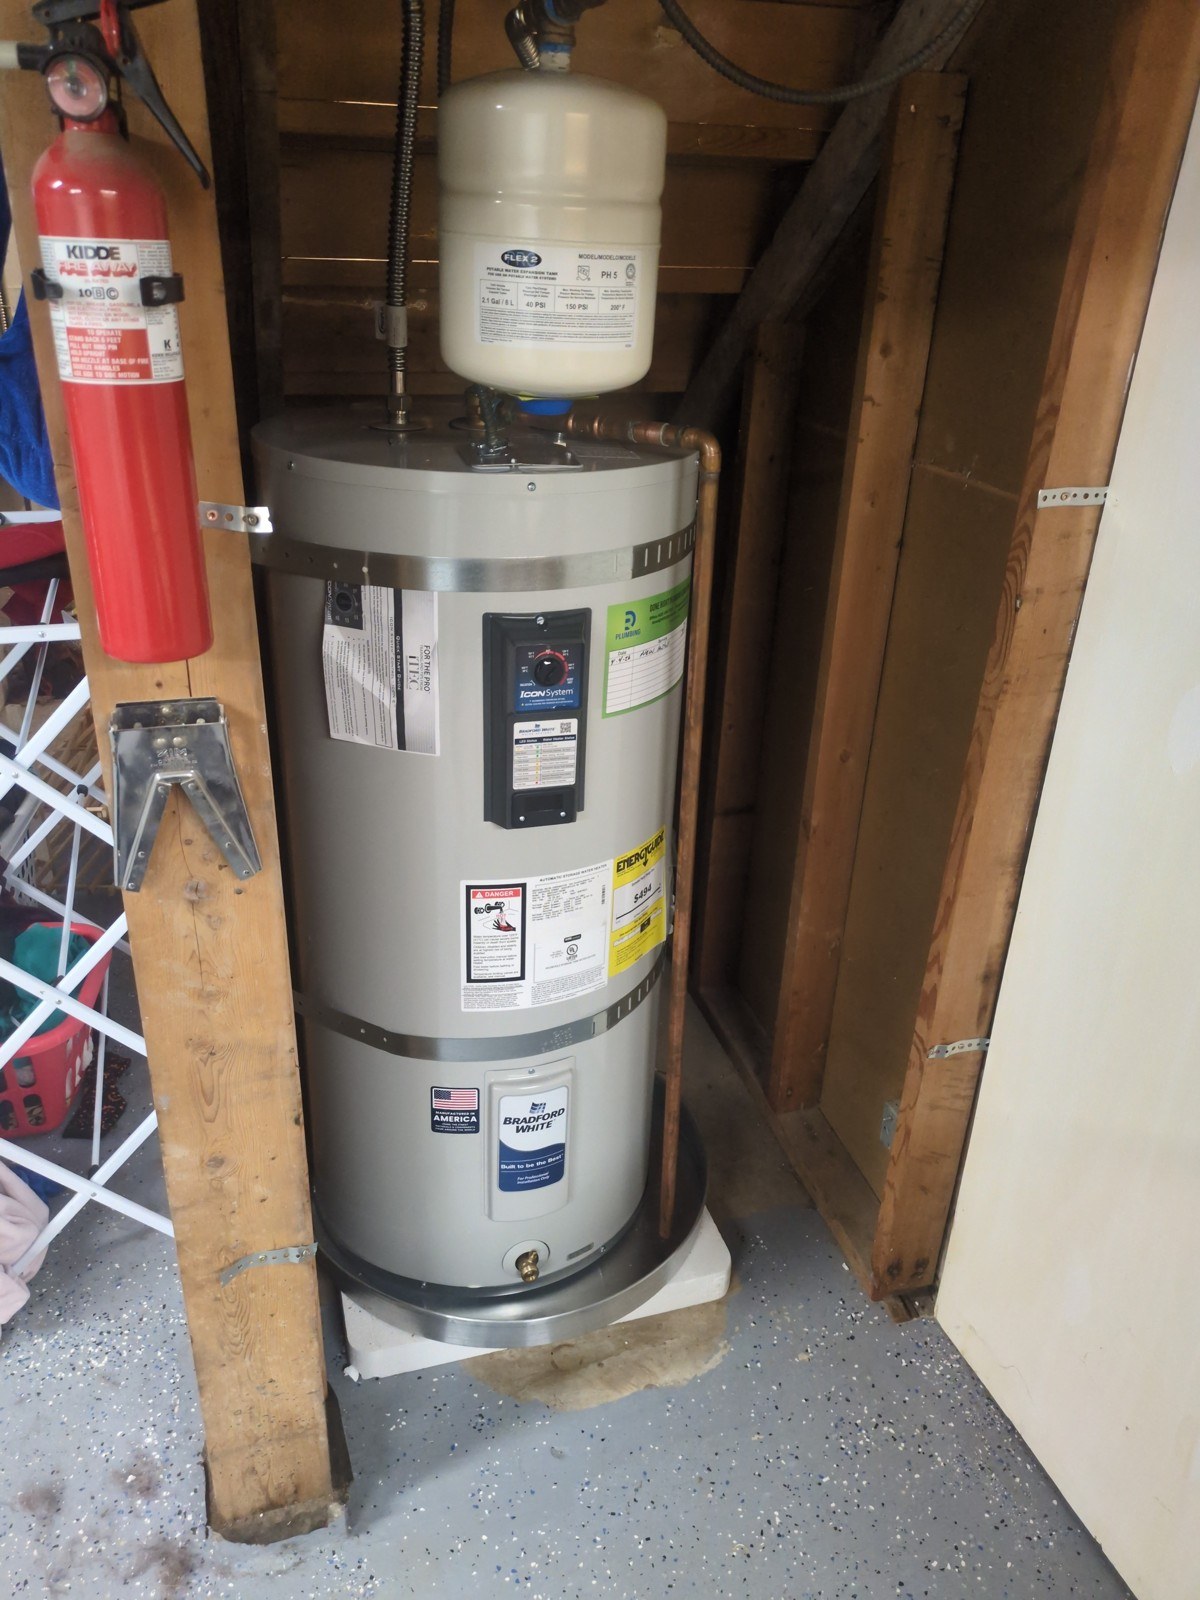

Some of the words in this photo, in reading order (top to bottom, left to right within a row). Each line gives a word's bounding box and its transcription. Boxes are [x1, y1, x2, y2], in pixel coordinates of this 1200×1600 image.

[66, 245, 121, 260] KIDDE
[504, 254, 528, 262] FLEX
[531, 255, 539, 263] 2
[601, 270, 612, 279] PH
[613, 271, 618, 279] 5
[490, 297, 501, 305] Gal
[534, 301, 546, 309] PSI
[615, 629, 641, 640] PLUMBING
[423, 645, 431, 660] FOR
[423, 661, 431, 674] THE
[433, 1114, 478, 1123] AMERICA
[503, 1107, 565, 1125] BRADFORD
[515, 1121, 553, 1134] WHITE
